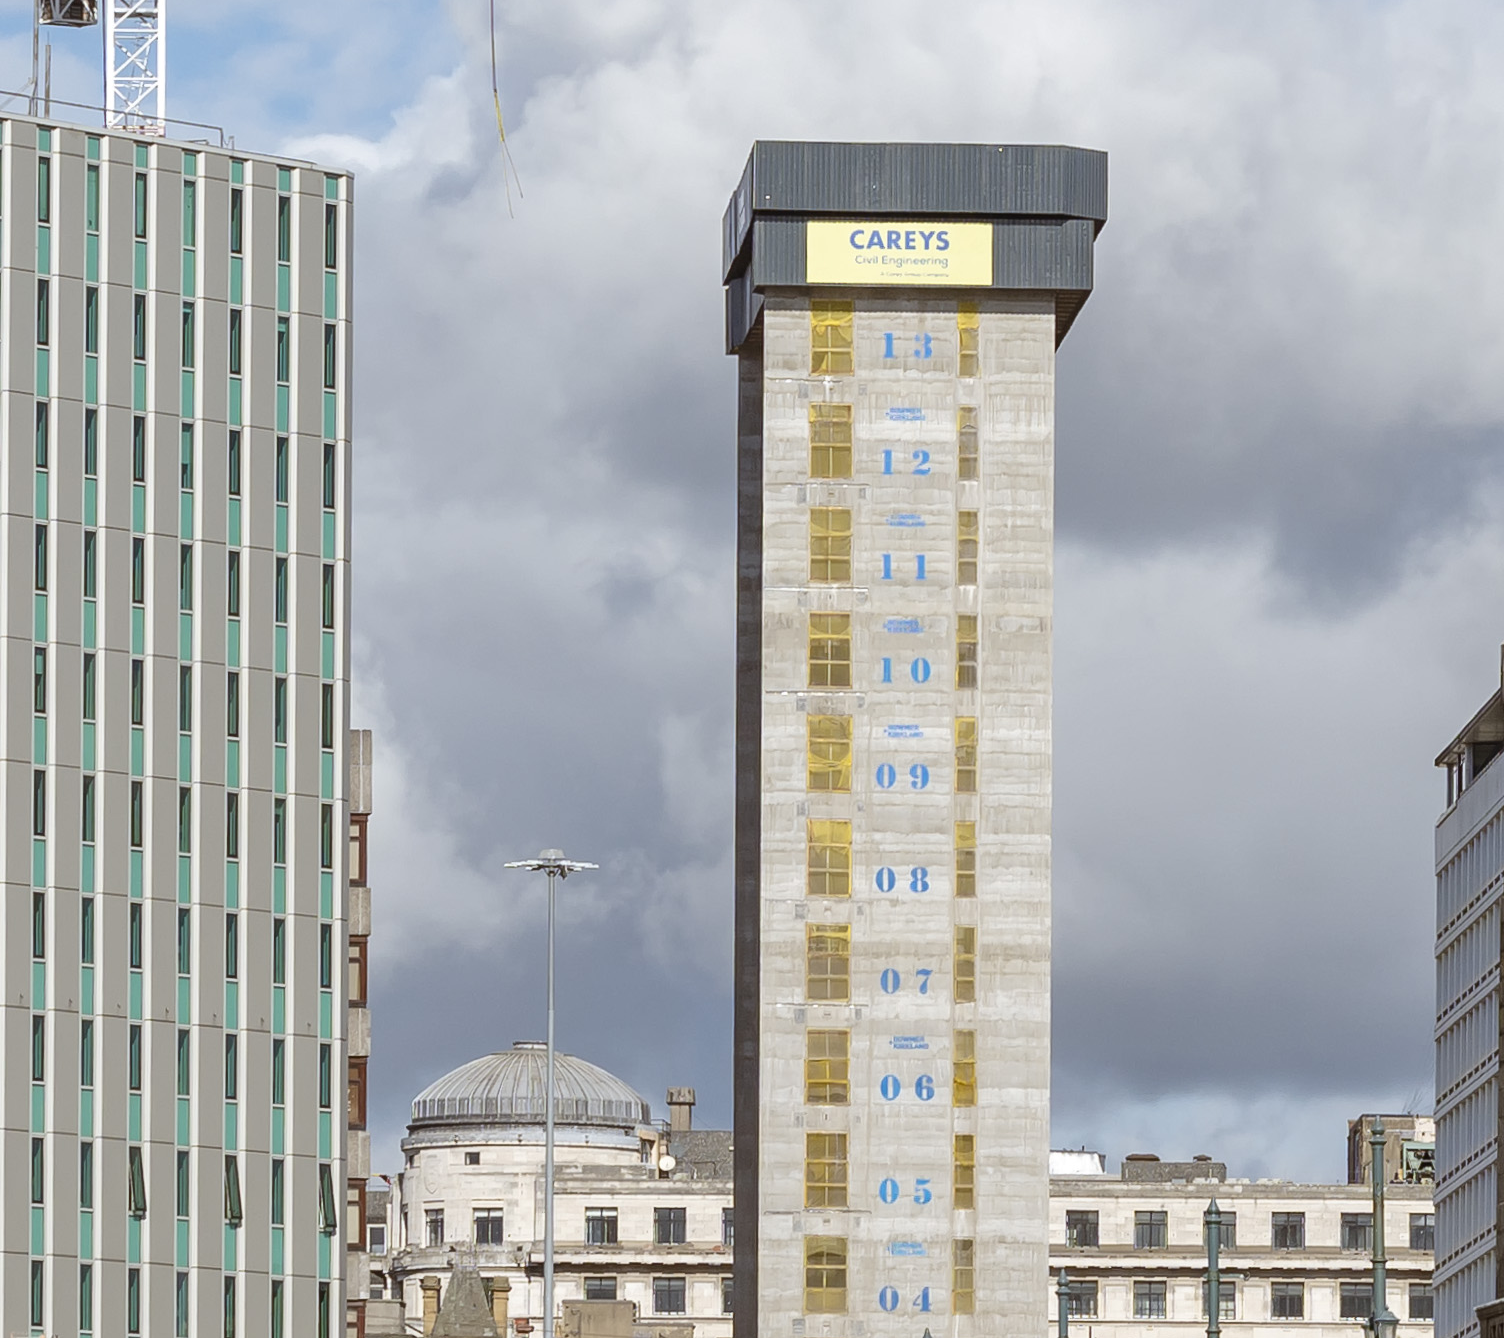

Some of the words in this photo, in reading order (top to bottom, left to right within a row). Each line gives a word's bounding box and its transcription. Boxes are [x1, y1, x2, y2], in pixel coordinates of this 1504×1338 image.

[849, 229, 950, 251] CAREYS
[855, 255, 879, 265] Civil
[881, 255, 949, 269] Engineering
[882, 332, 934, 360] 13
[881, 448, 932, 476] 12
[880, 553, 928, 581] 11
[880, 656, 932, 685] 10
[875, 762, 931, 790] 09
[874, 866, 931, 894] 08
[880, 968, 934, 995] 07
[879, 1073, 936, 1102] 06
[878, 1177, 933, 1206] 05
[878, 1286, 933, 1313] 04
